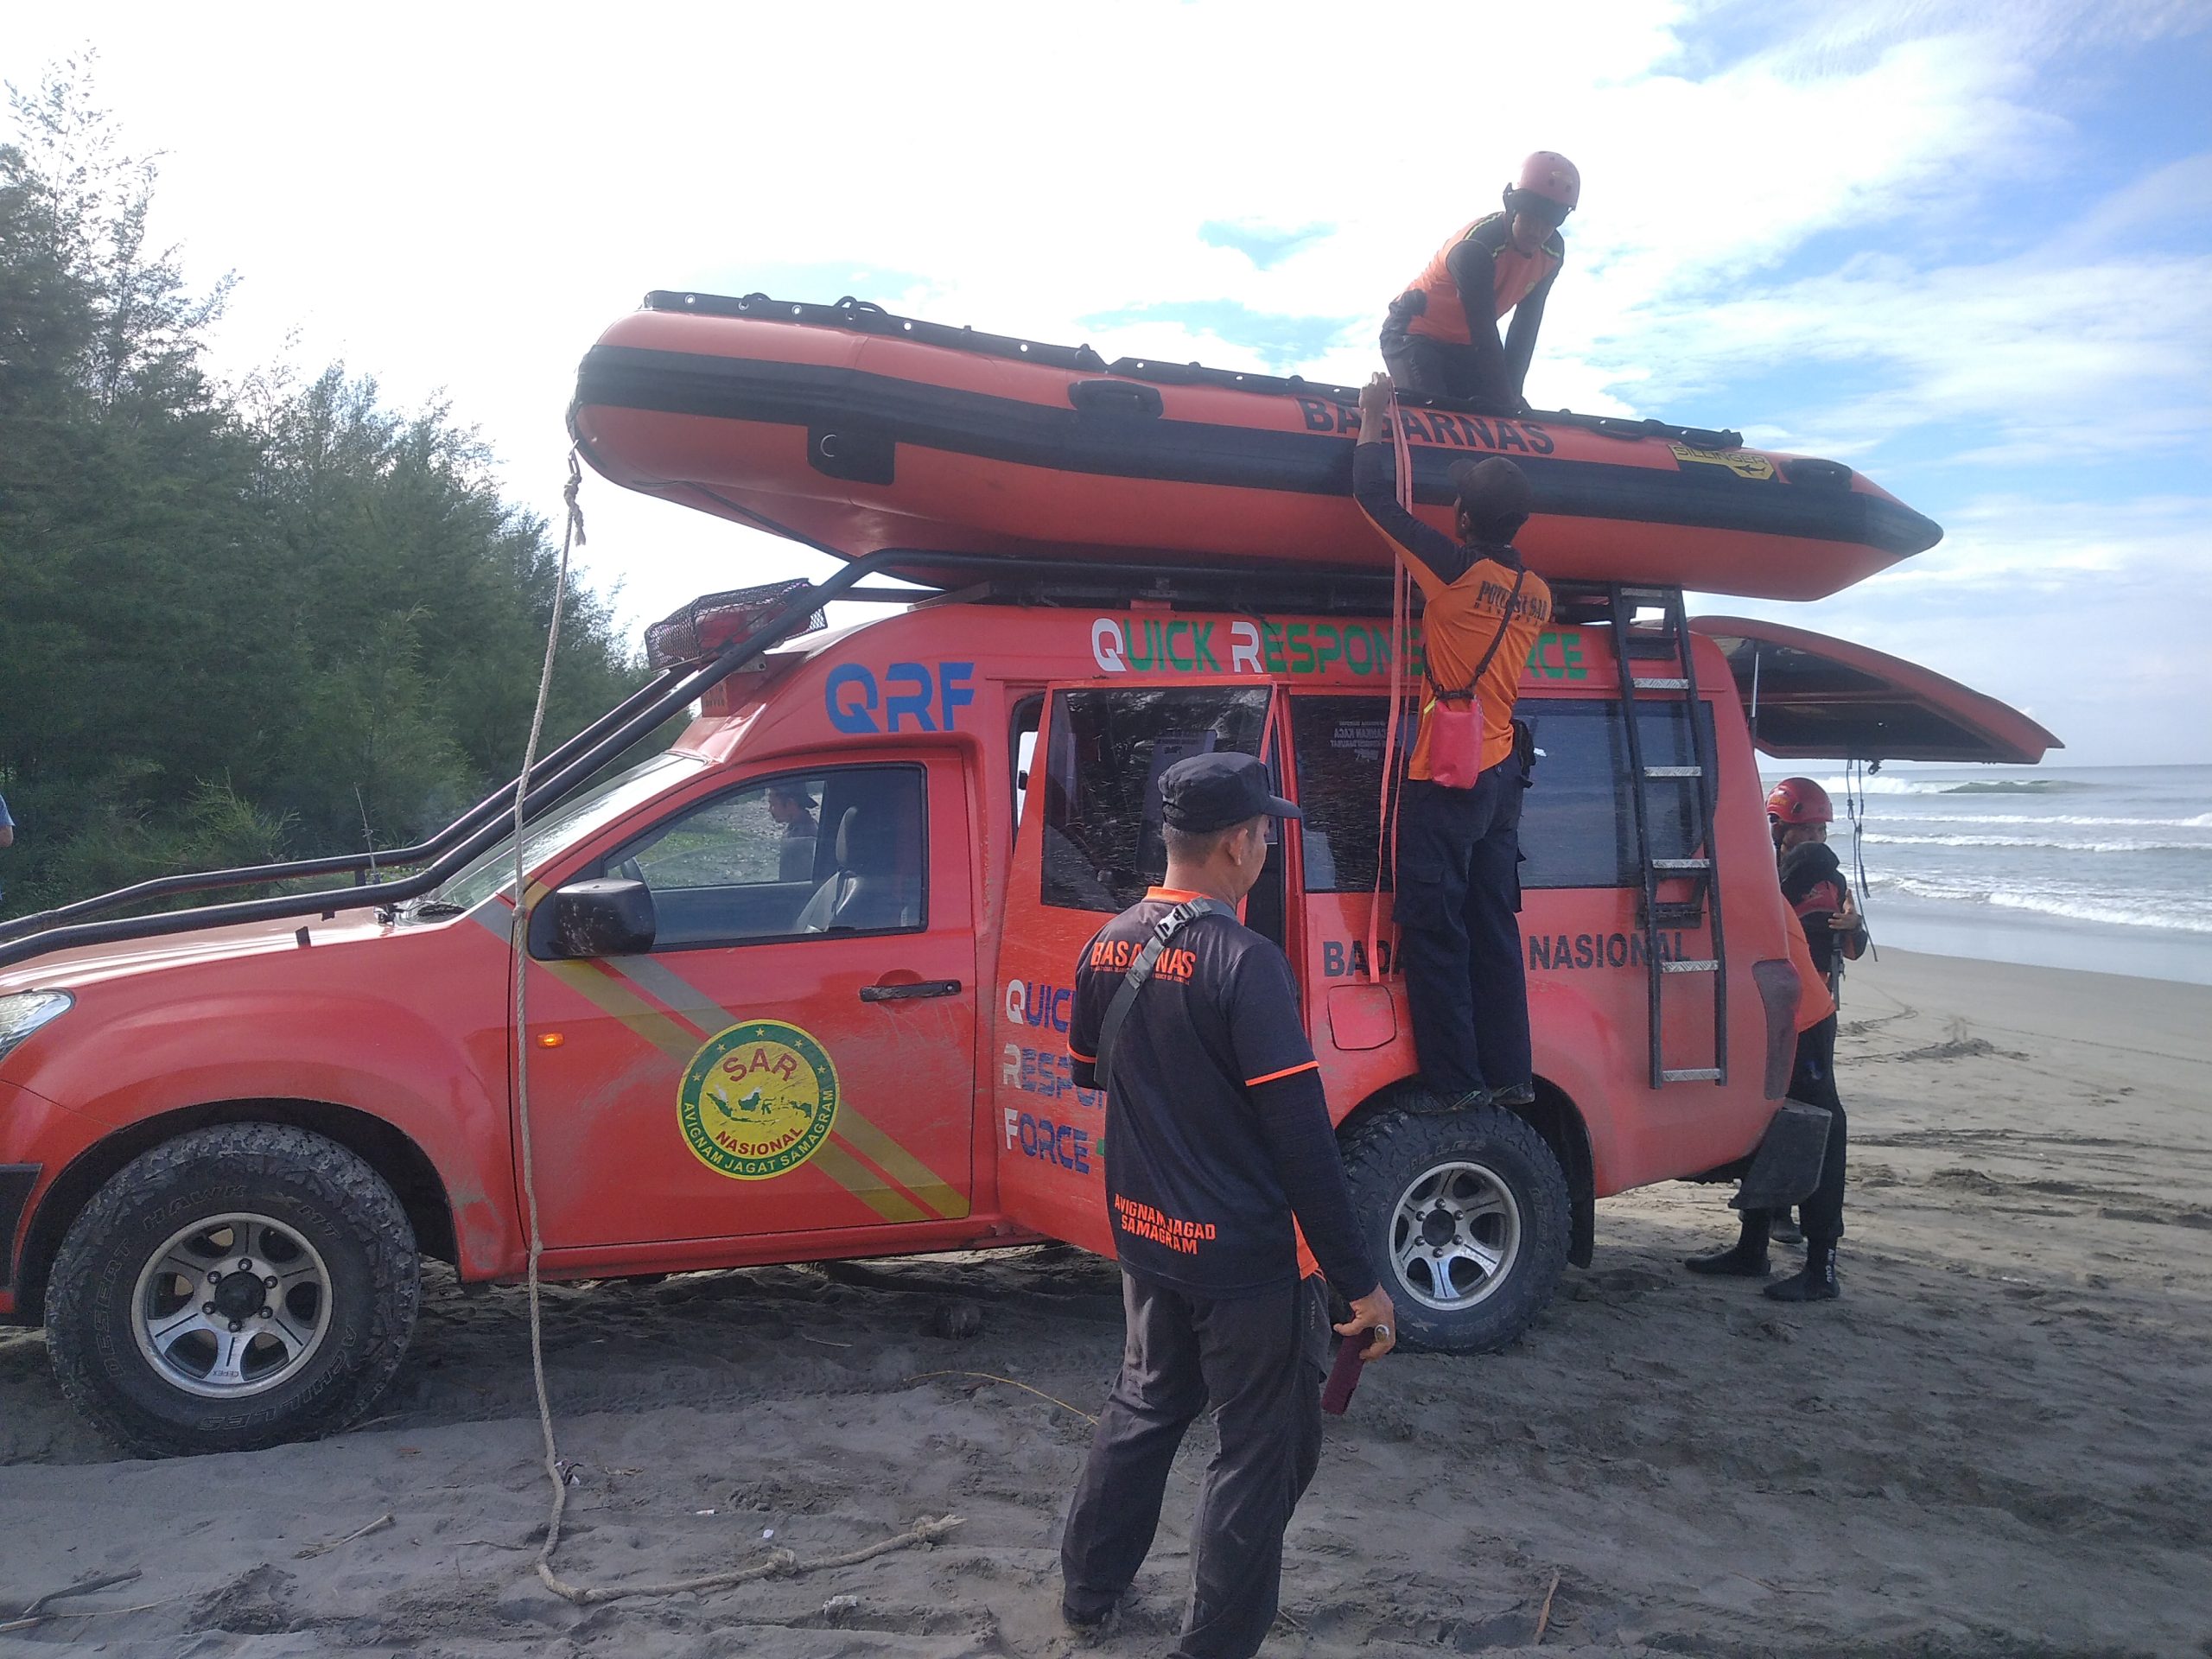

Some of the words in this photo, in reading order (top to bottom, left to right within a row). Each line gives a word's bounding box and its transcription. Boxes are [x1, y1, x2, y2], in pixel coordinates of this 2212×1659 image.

[1091, 619, 1221, 673] QUICK
[1231, 621, 1424, 676] RESPONS
[825, 662, 975, 734] QRF
[1090, 940, 1196, 978] BASANAS
[1006, 978, 1076, 1033] QUIC
[722, 1048, 798, 1082] SAR
[683, 1102, 724, 1165] AVIGNAM
[724, 1159, 776, 1173] JAGAT
[780, 1089, 834, 1166] SAMAGRAM
[715, 1126, 804, 1155] NASIONAL
[1004, 1107, 1089, 1174] FORCE
[1114, 1193, 1166, 1229] AVIGNAM
[1121, 1213, 1198, 1255] SAMAGRAM
